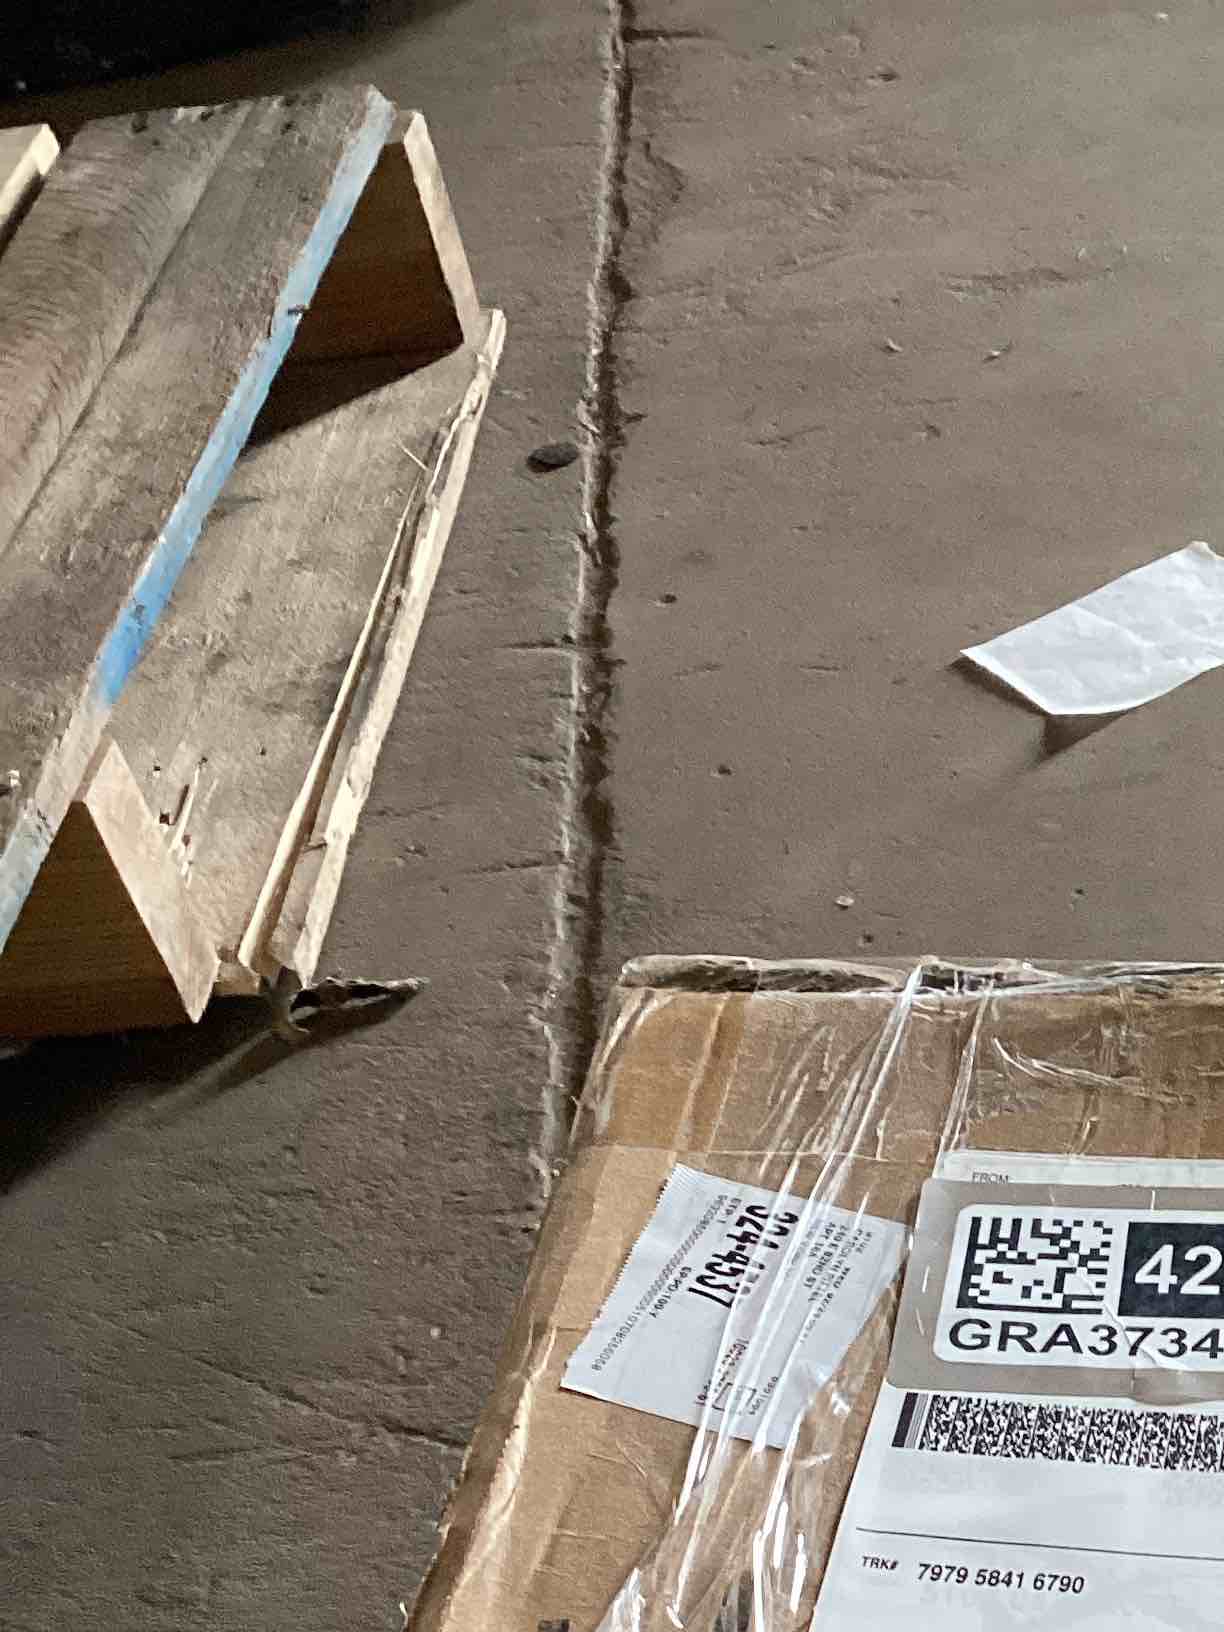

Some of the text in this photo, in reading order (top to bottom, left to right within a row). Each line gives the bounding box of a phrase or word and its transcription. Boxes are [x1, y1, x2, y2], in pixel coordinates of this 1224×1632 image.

[861, 1555, 1085, 1594] TRK# 7979 5841 6790
